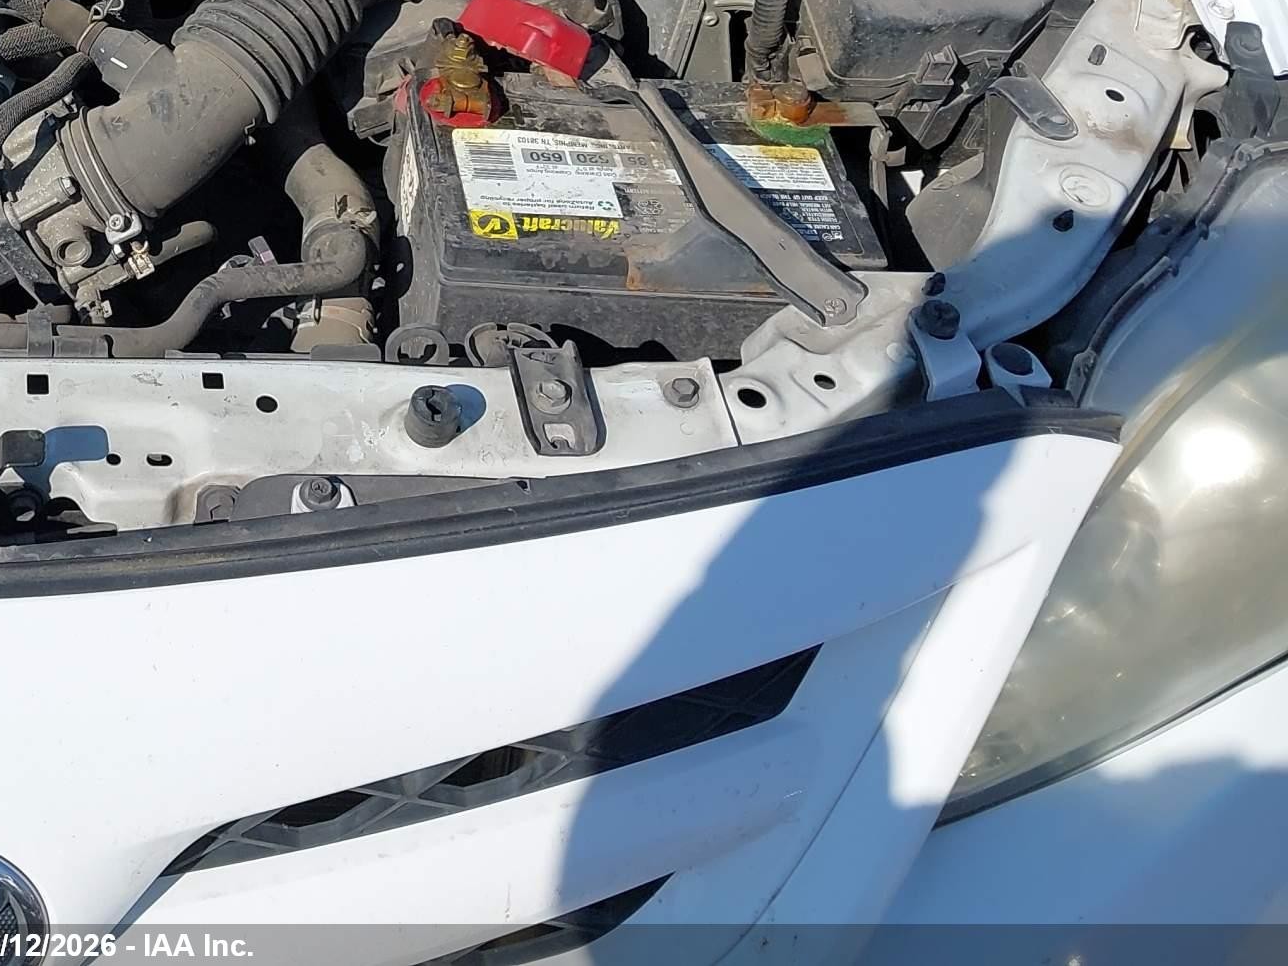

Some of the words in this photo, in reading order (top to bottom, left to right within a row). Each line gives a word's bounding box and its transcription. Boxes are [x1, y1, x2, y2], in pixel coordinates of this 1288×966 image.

[530, 151, 562, 163] 650
[576, 153, 609, 164] 520
[521, 217, 619, 239] Valucraft
